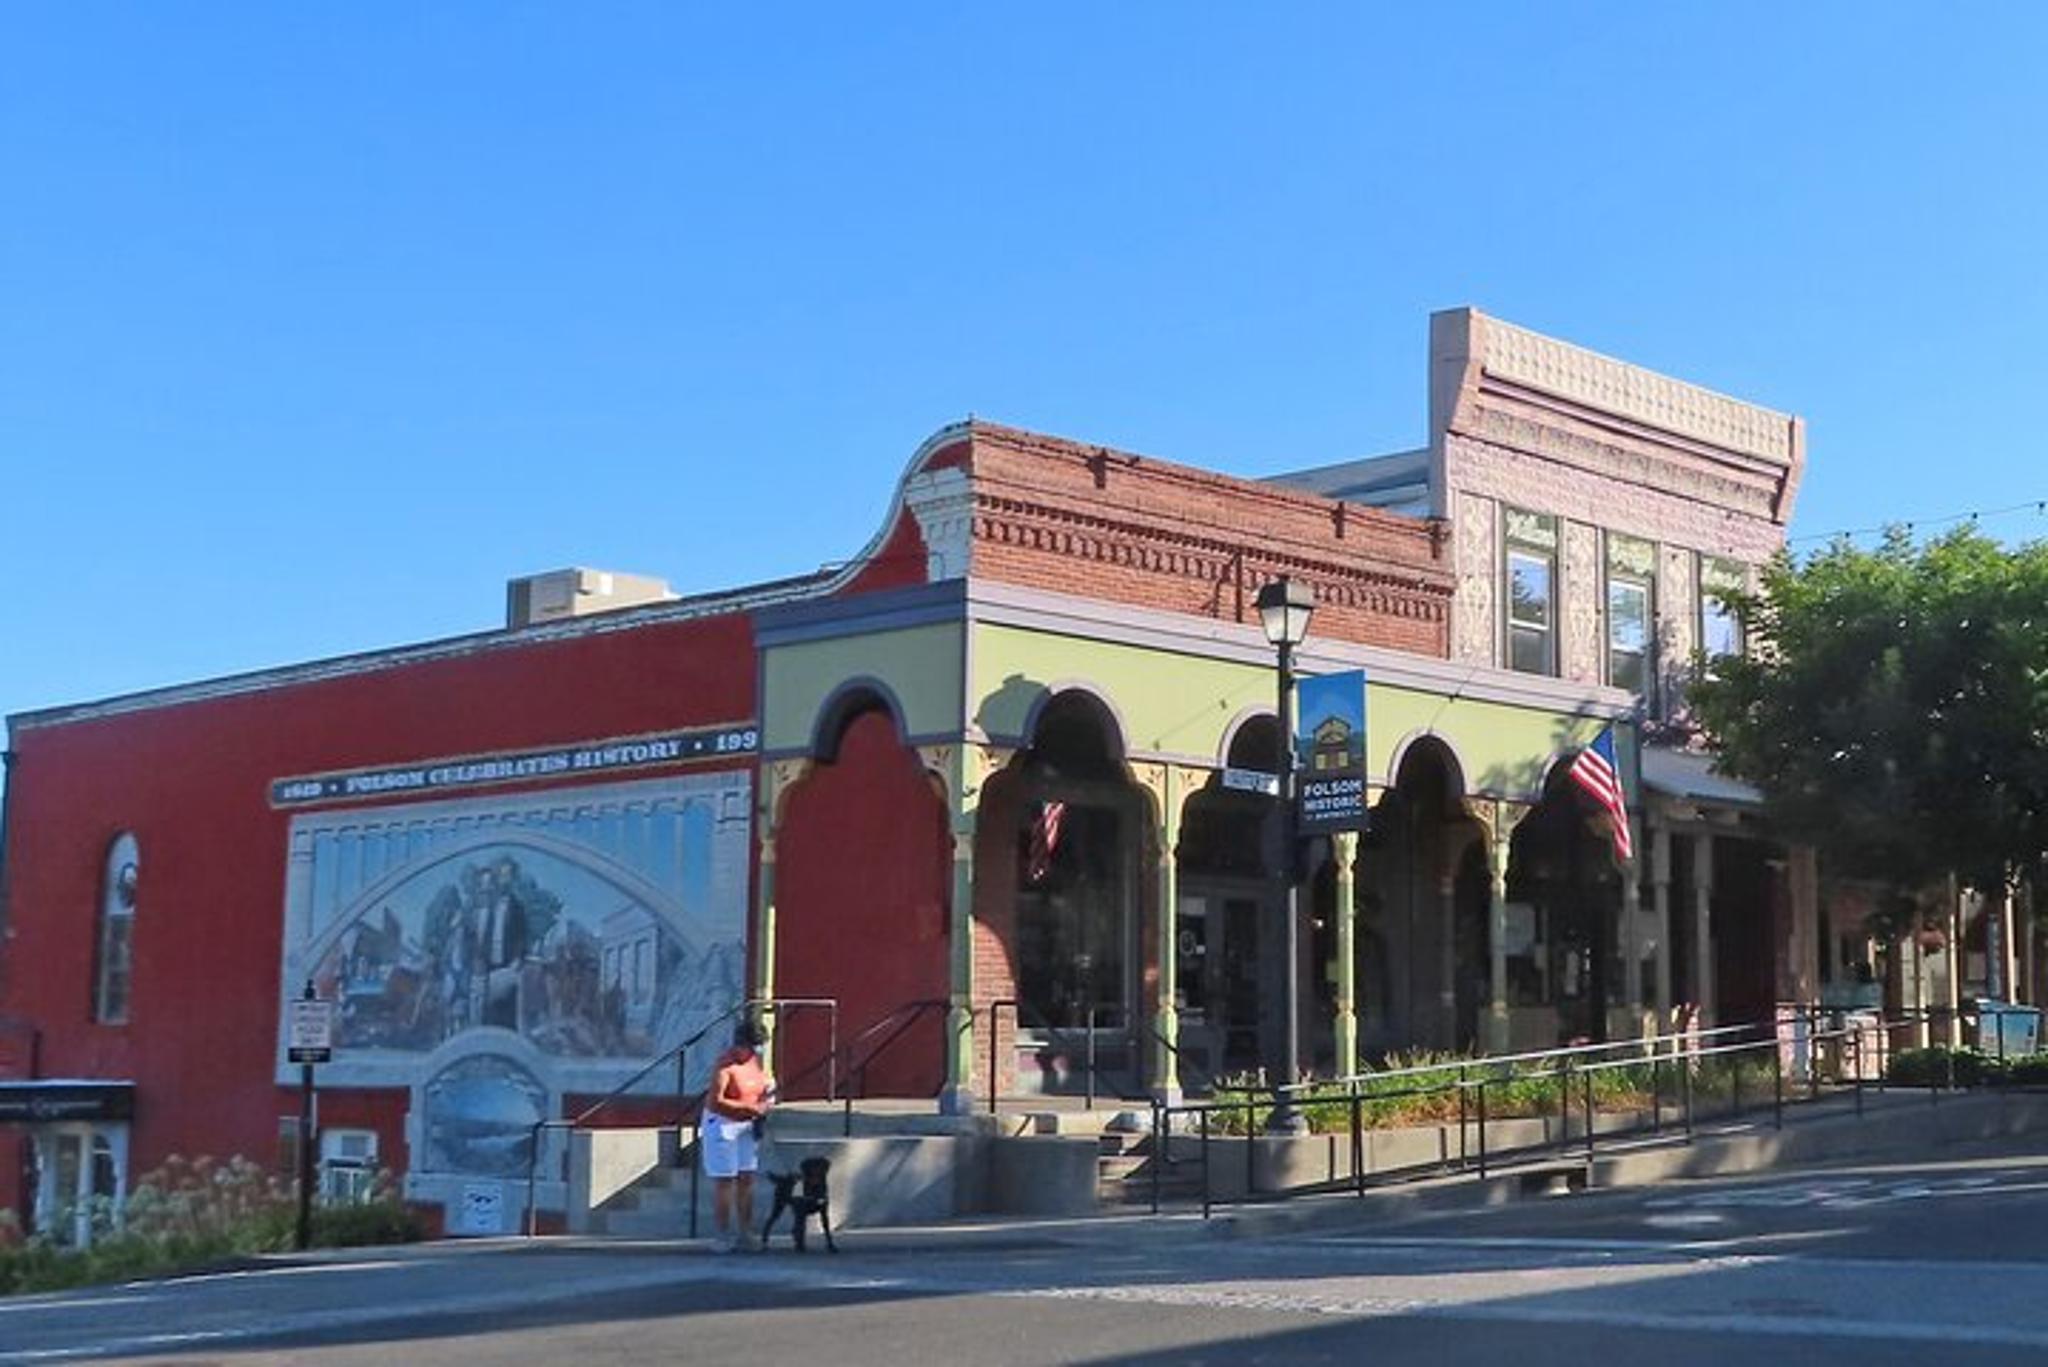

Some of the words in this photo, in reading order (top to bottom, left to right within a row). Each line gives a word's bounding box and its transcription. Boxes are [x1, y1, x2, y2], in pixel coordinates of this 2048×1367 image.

[346, 770, 426, 793] FOLSOM
[430, 754, 568, 784] CELEBRATES
[573, 740, 681, 768] HISTORY
[1303, 779, 1362, 797] FOLSOM
[1303, 794, 1362, 811] HISTORIC
